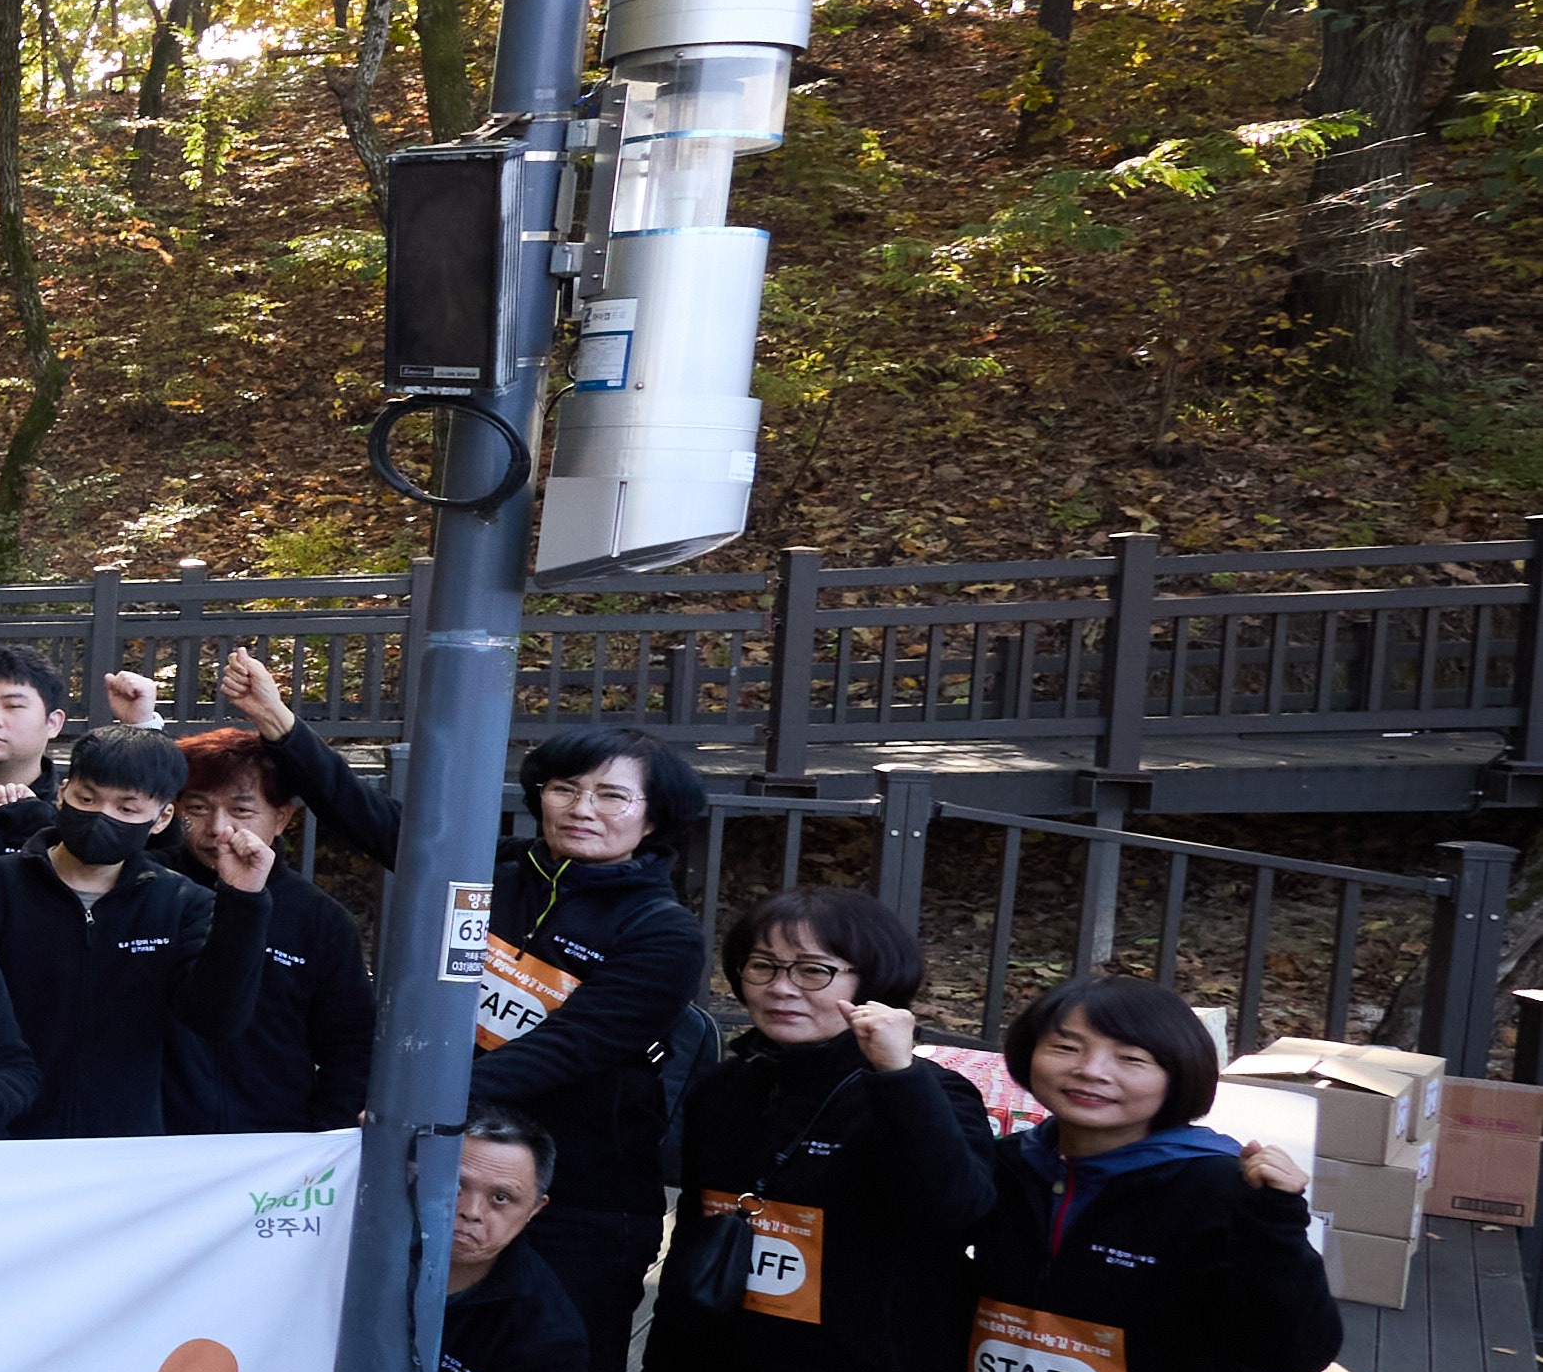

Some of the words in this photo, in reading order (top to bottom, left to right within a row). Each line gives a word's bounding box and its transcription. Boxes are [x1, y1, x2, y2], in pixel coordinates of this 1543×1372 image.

[479, 983, 545, 1031] AFF
[254, 1215, 321, 1239] 양주시
[748, 1250, 800, 1281] FF
